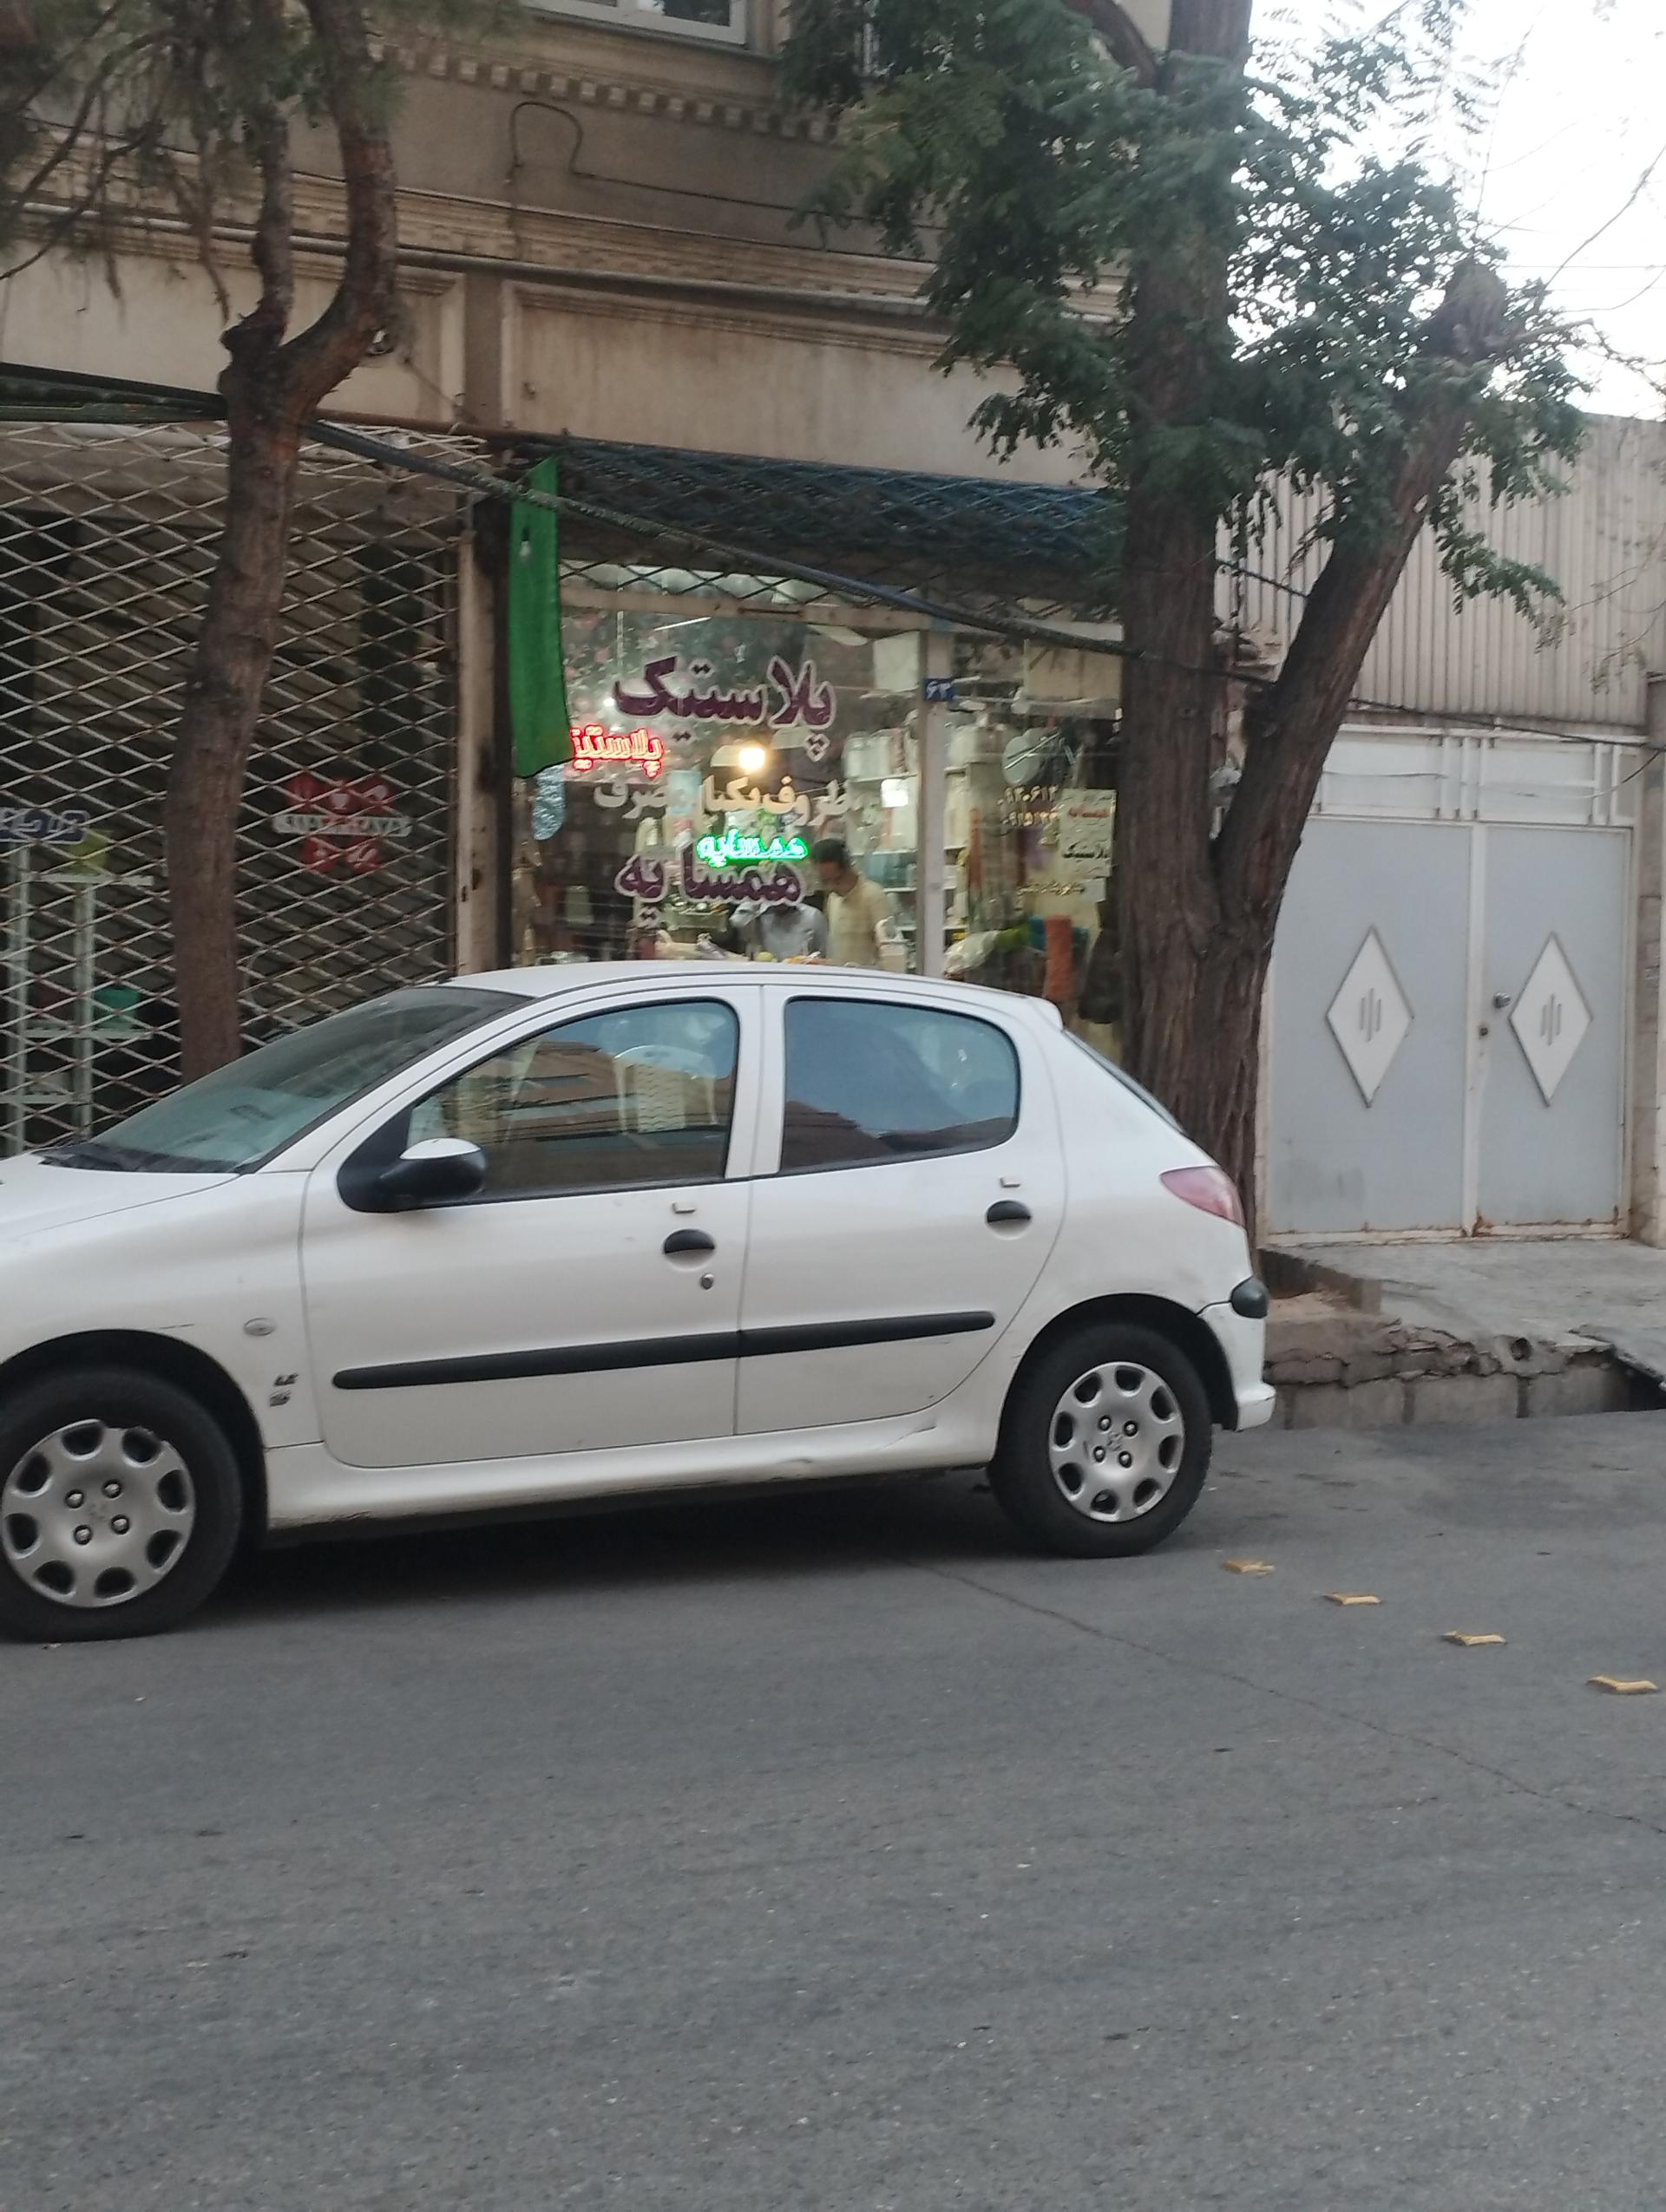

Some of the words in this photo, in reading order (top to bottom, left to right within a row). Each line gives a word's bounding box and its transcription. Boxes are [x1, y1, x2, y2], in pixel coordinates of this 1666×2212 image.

[612, 655, 836, 762] پلاستیک
[692, 774, 761, 815] یکبا
[696, 829, 810, 868] همسایه
[614, 841, 806, 926] همسایه
